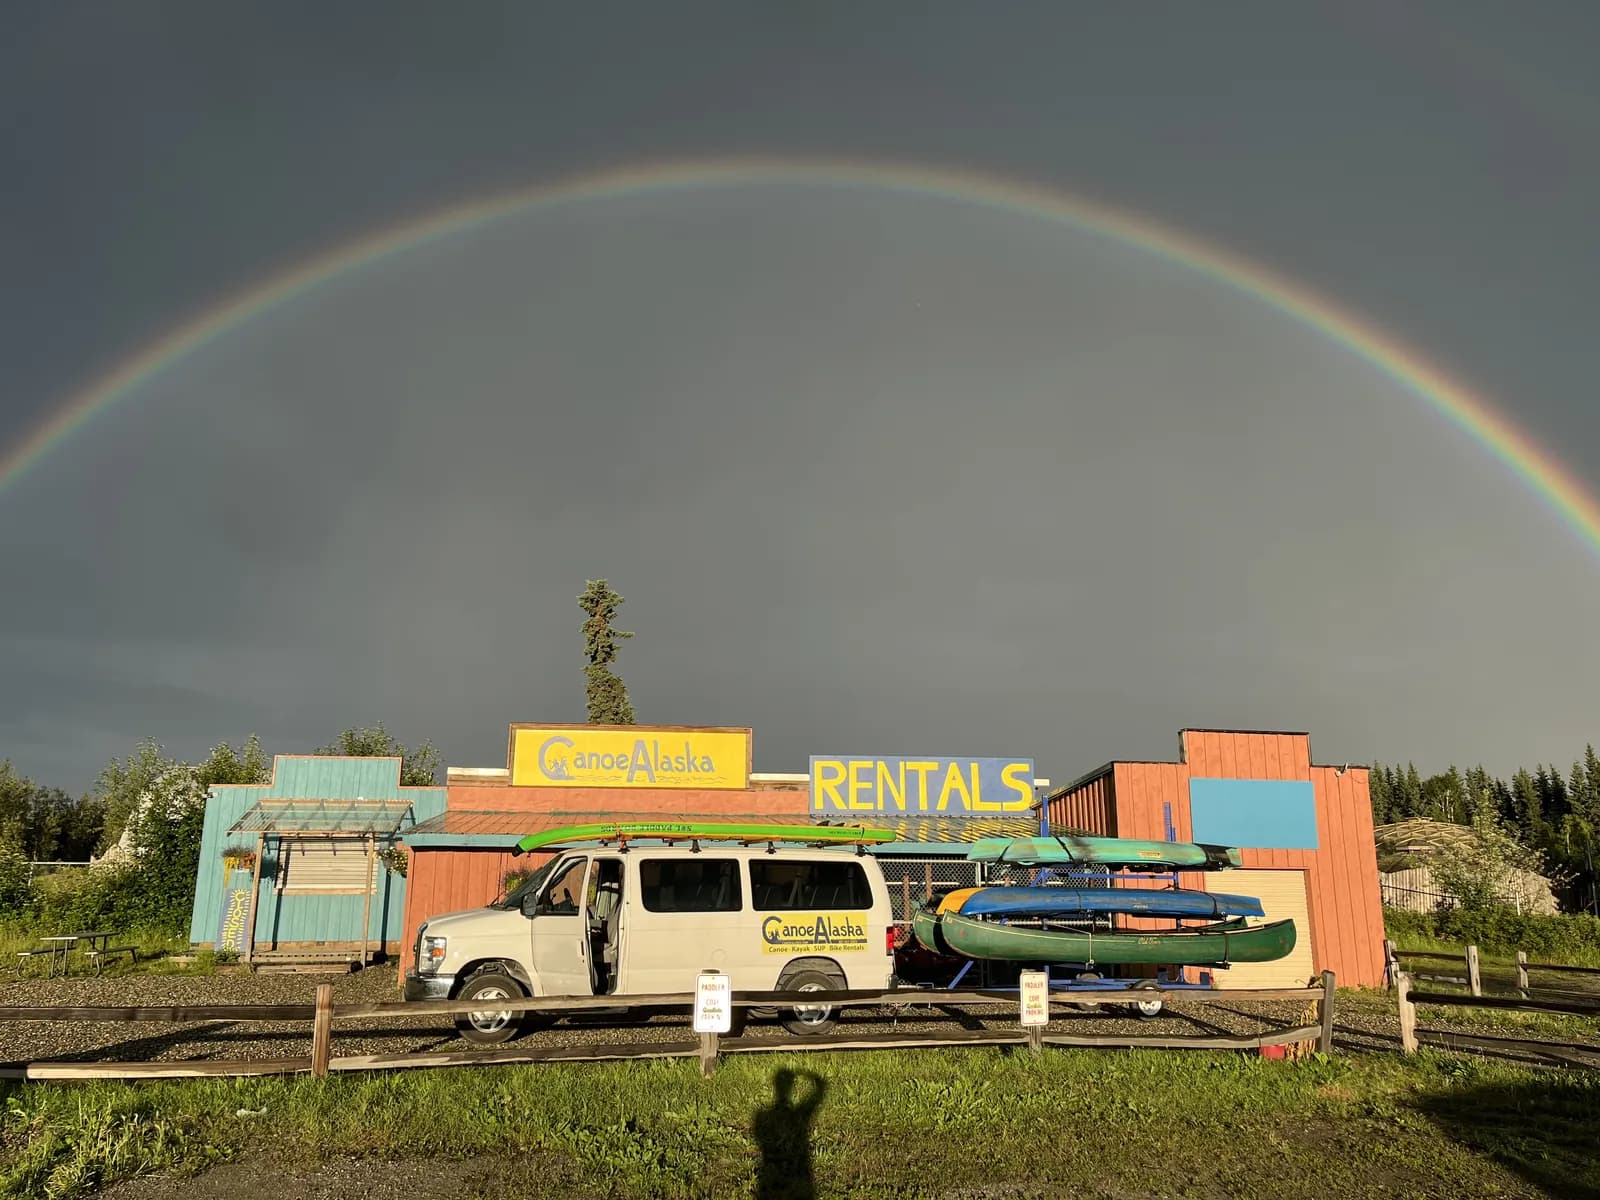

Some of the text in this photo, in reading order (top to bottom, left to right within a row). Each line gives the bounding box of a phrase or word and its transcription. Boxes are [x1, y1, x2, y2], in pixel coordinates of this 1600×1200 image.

[813, 760, 1033, 812] RENTALS
[226, 891, 246, 949] CLOSED
[701, 983, 725, 991] PADDLER
